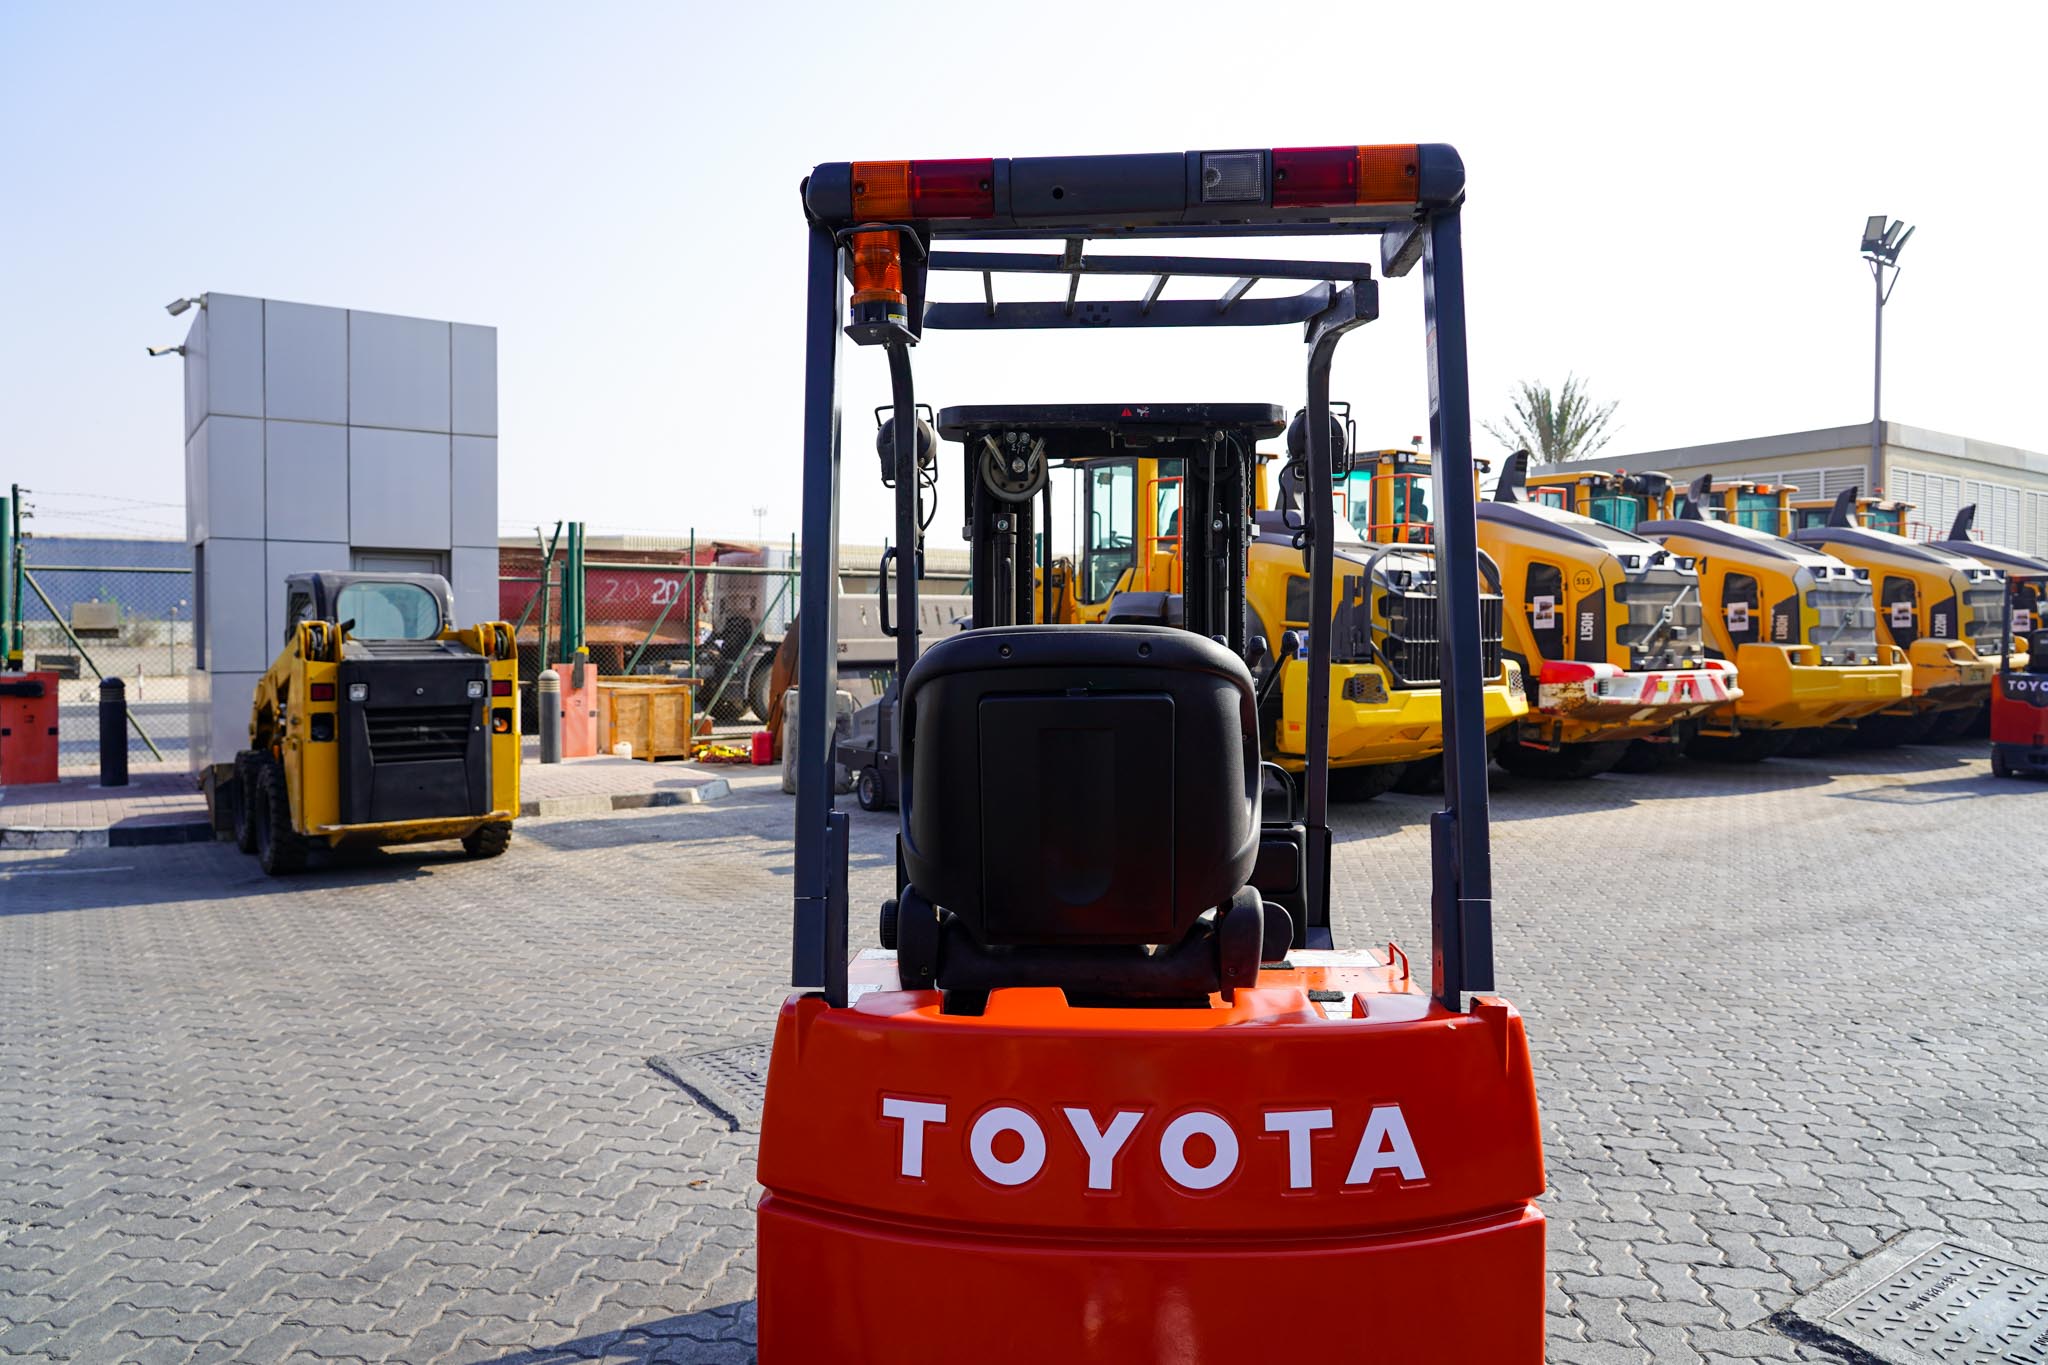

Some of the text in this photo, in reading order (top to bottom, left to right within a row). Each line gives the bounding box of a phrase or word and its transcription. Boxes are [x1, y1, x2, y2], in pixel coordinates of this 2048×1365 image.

[652, 577, 680, 604] 20
[1580, 612, 1594, 641] L150H
[882, 1097, 1427, 1190] TOYOTA
